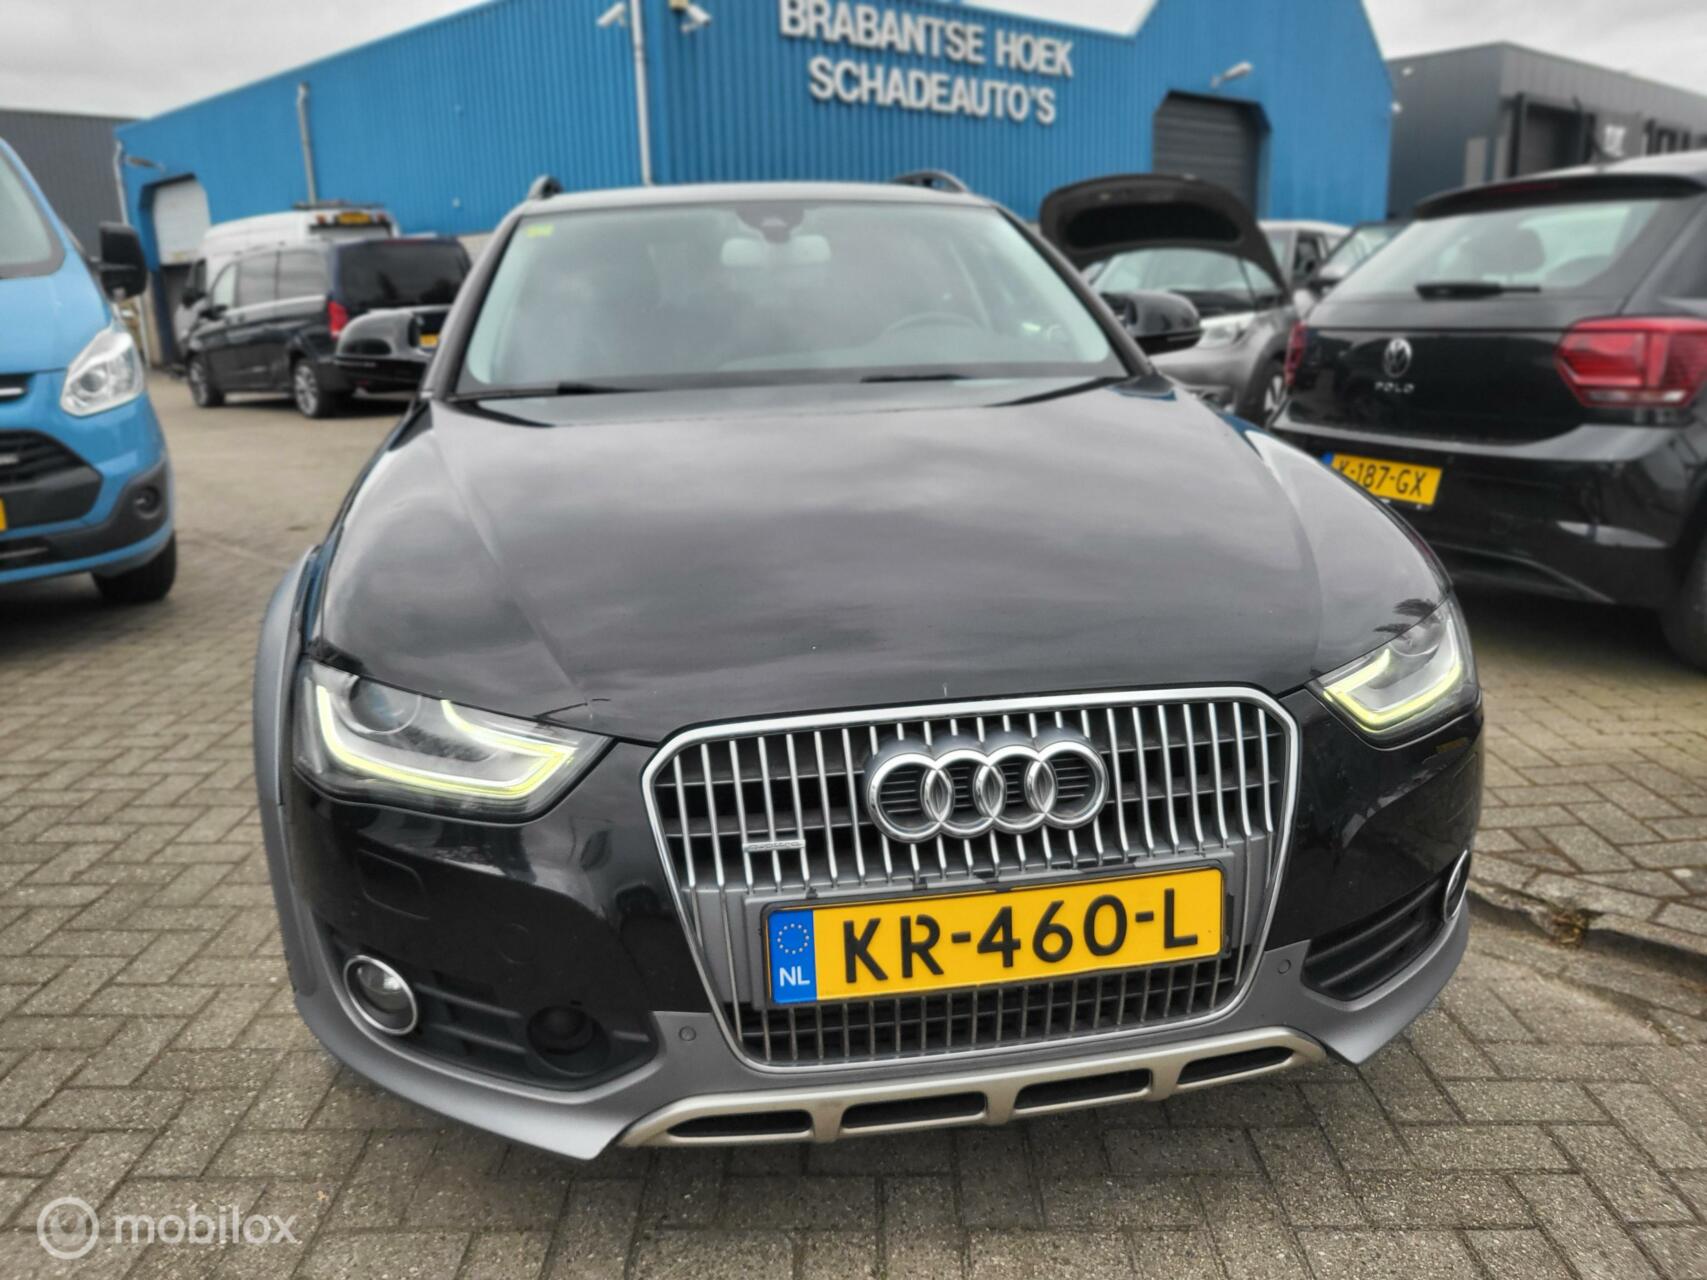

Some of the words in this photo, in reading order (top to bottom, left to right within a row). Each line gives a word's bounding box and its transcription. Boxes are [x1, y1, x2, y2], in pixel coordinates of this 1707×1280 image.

[779, 0, 986, 63] BRABANTSE
[995, 29, 1074, 77] HOEK
[808, 56, 1056, 123] SCHADEAUTO'S
[1375, 381, 1415, 393] POLO
[842, 888, 1198, 983] KR-460-L
[779, 966, 810, 987] NL
